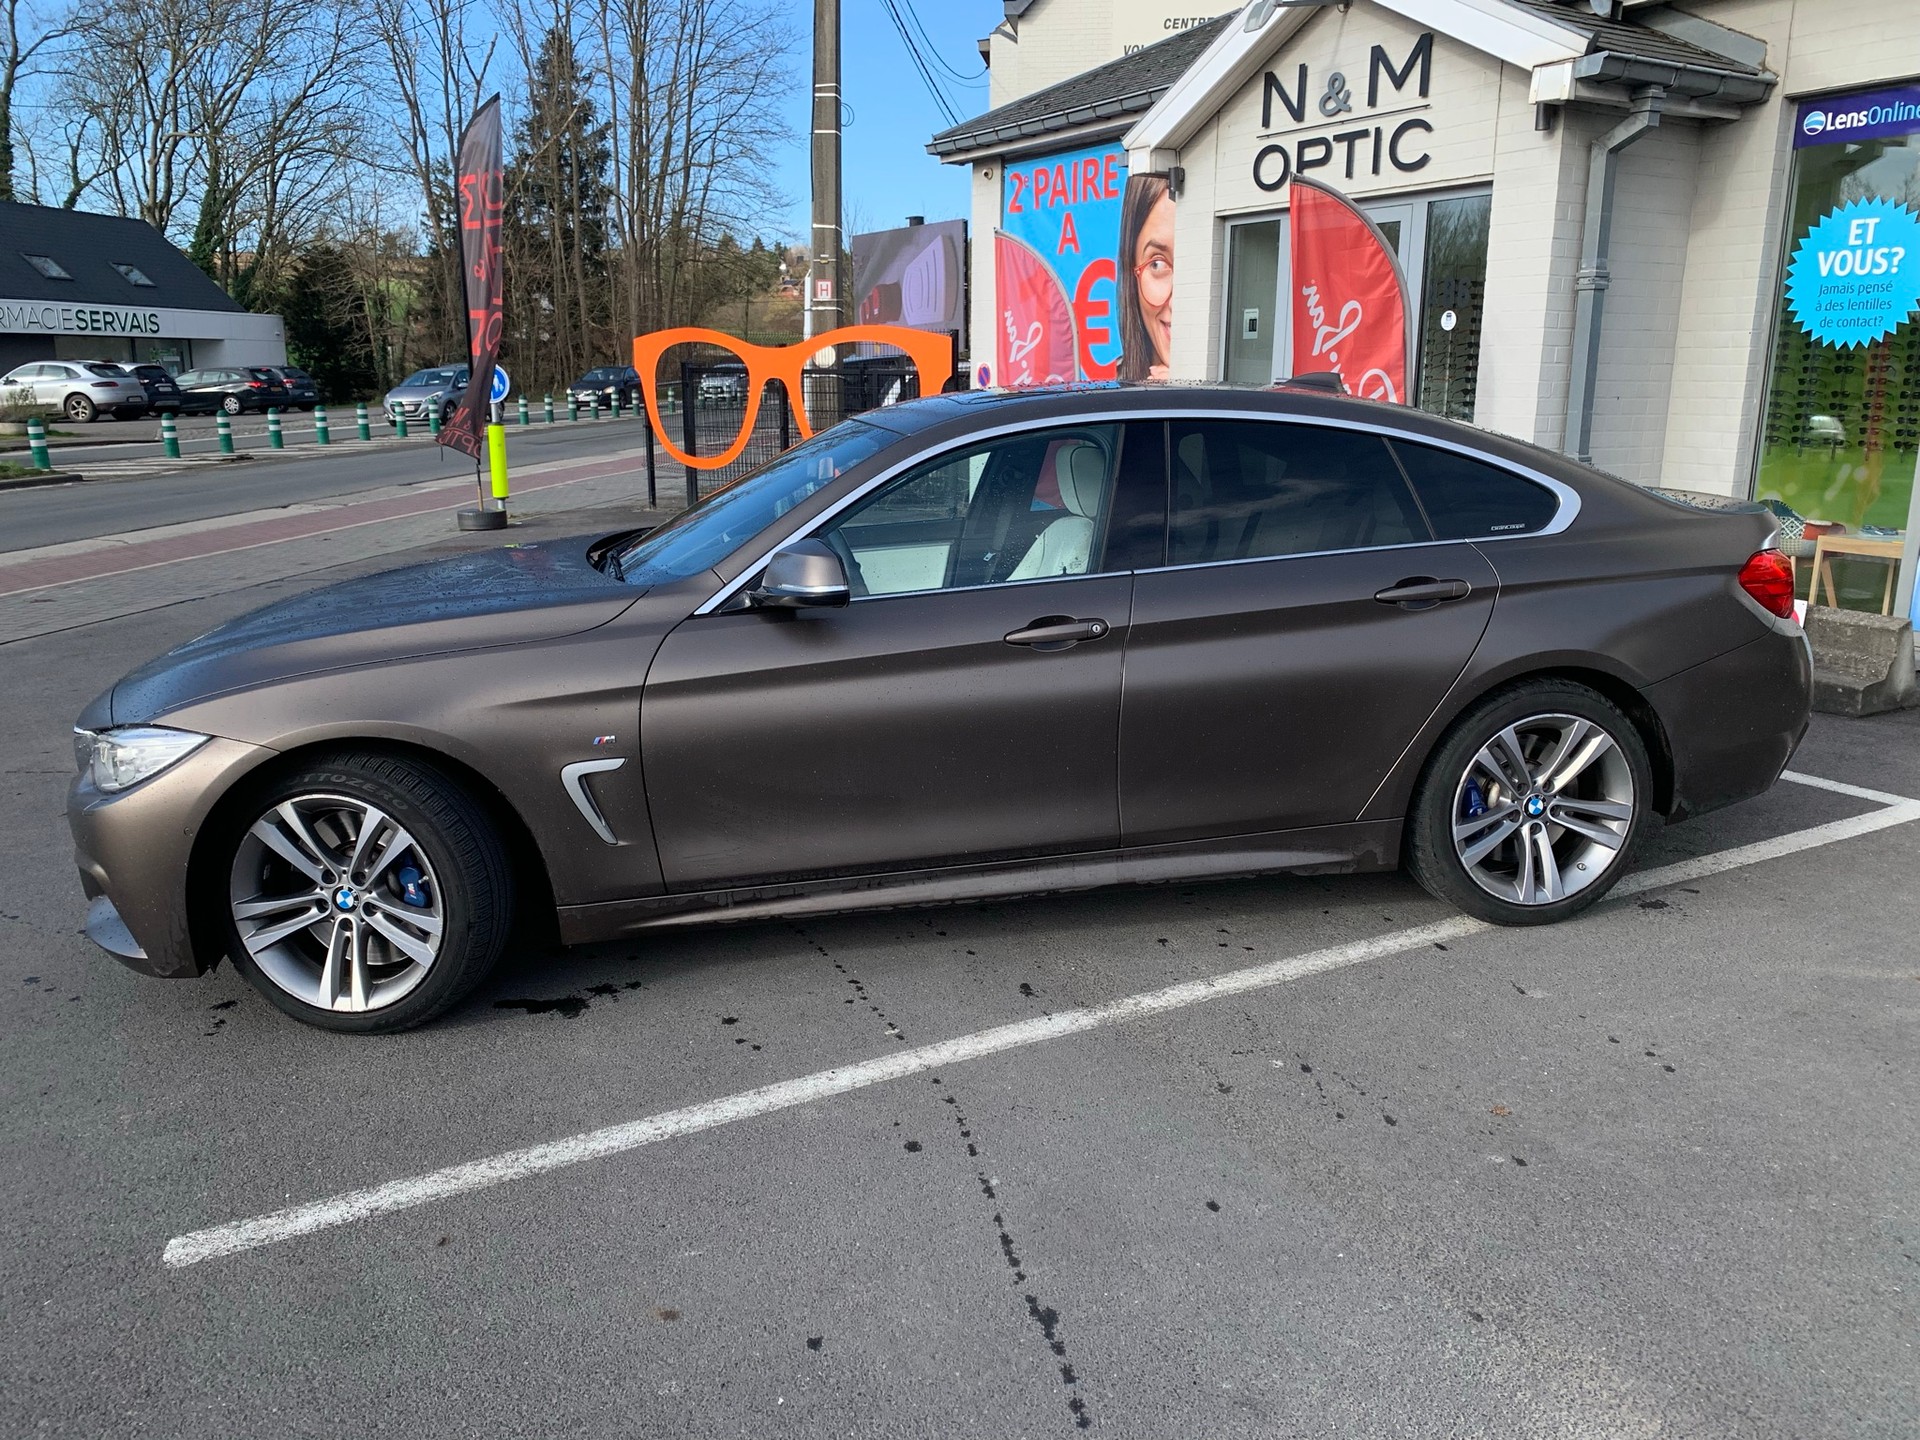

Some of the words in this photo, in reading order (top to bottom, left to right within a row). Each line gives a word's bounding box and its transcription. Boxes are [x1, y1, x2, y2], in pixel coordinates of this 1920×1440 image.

[1163, 16, 1215, 30] CENT
[1262, 63, 1307, 129] N
[1319, 72, 1351, 117] &
[1367, 32, 1434, 108] M
[1253, 118, 1434, 192] OPTIC
[1033, 154, 1120, 211] PAIRE
[1058, 212, 1081, 255] A
[1848, 217, 1881, 246] ET
[1818, 246, 1906, 278] VOUS?
[1818, 281, 1856, 298] Jamais
[1857, 279, 1894, 295] pensé
[1815, 299, 1823, 312] à
[1825, 299, 1845, 312] des
[1847, 297, 1893, 312] lentilles
[1820, 315, 1834, 328] de
[1836, 314, 1884, 328] contact?
